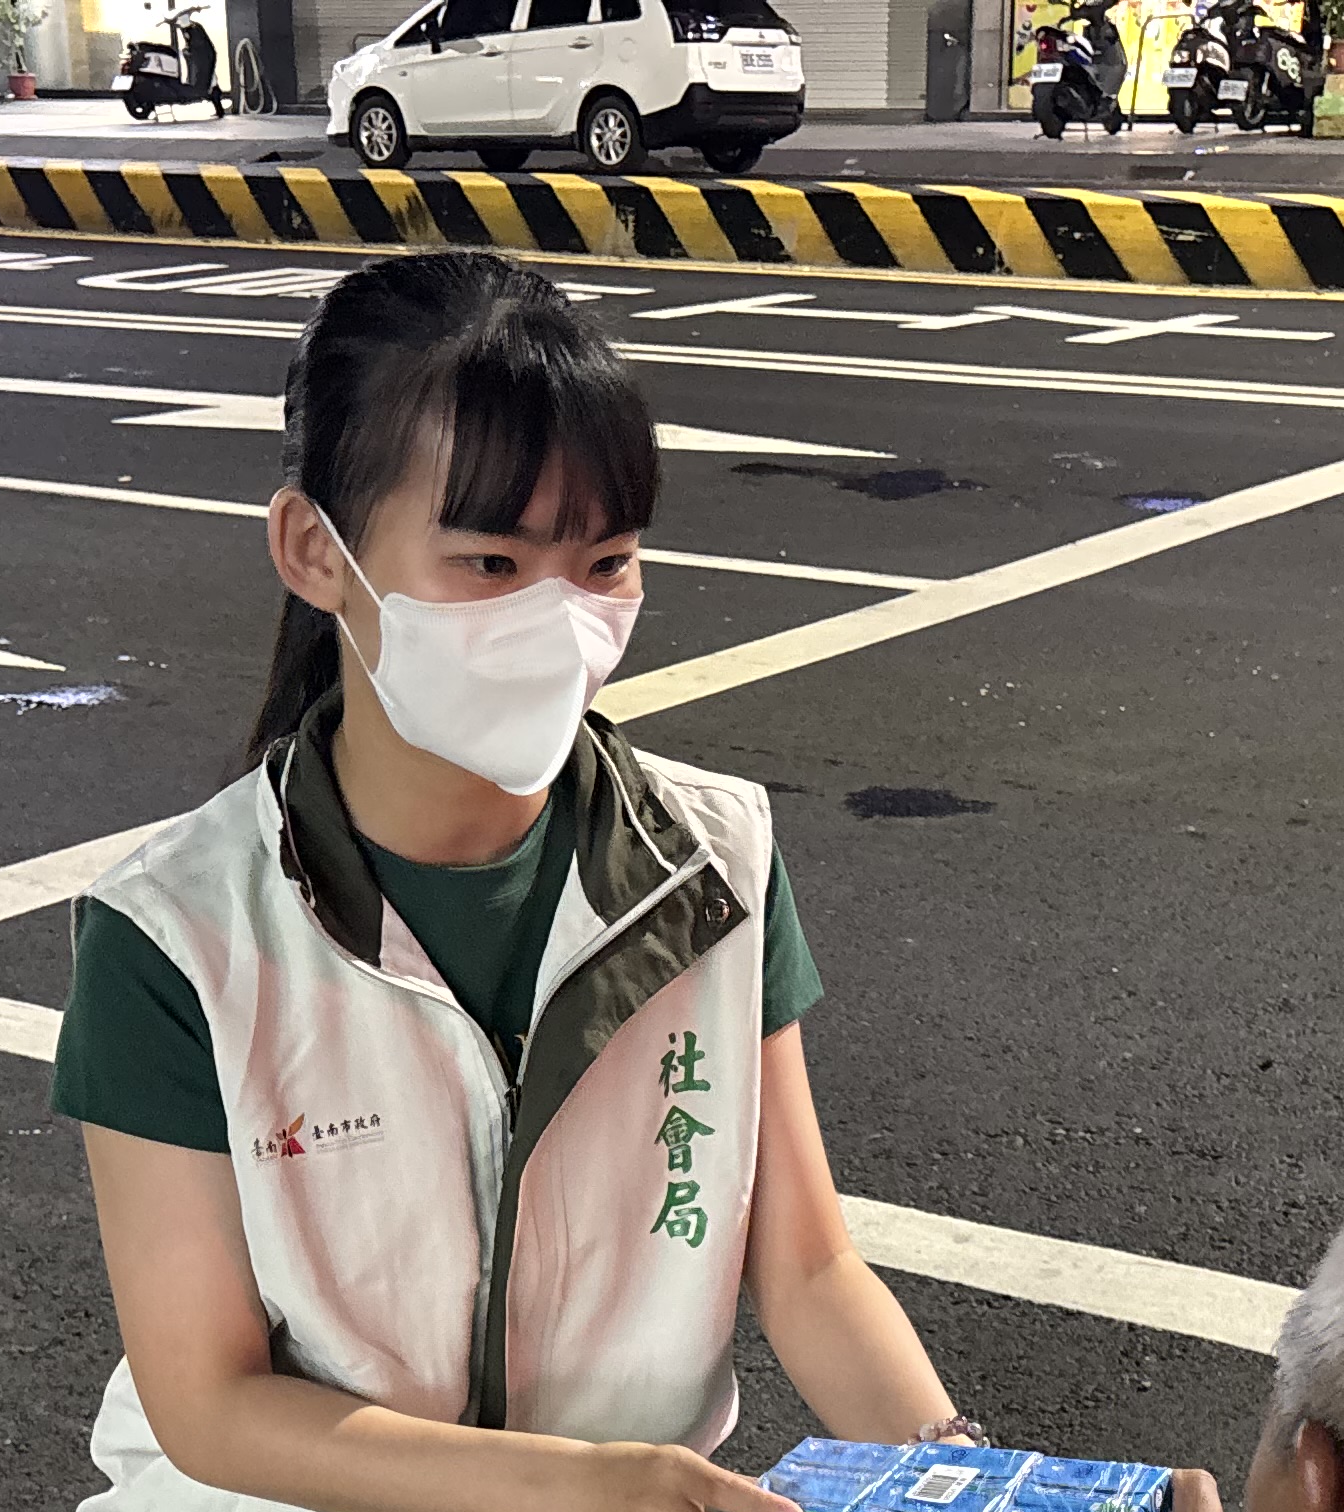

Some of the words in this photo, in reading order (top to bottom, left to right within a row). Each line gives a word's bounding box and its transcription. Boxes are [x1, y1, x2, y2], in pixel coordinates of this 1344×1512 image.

[312, 1113, 381, 1140] 臺南市政府
[649, 1030, 715, 1248] 社會局
